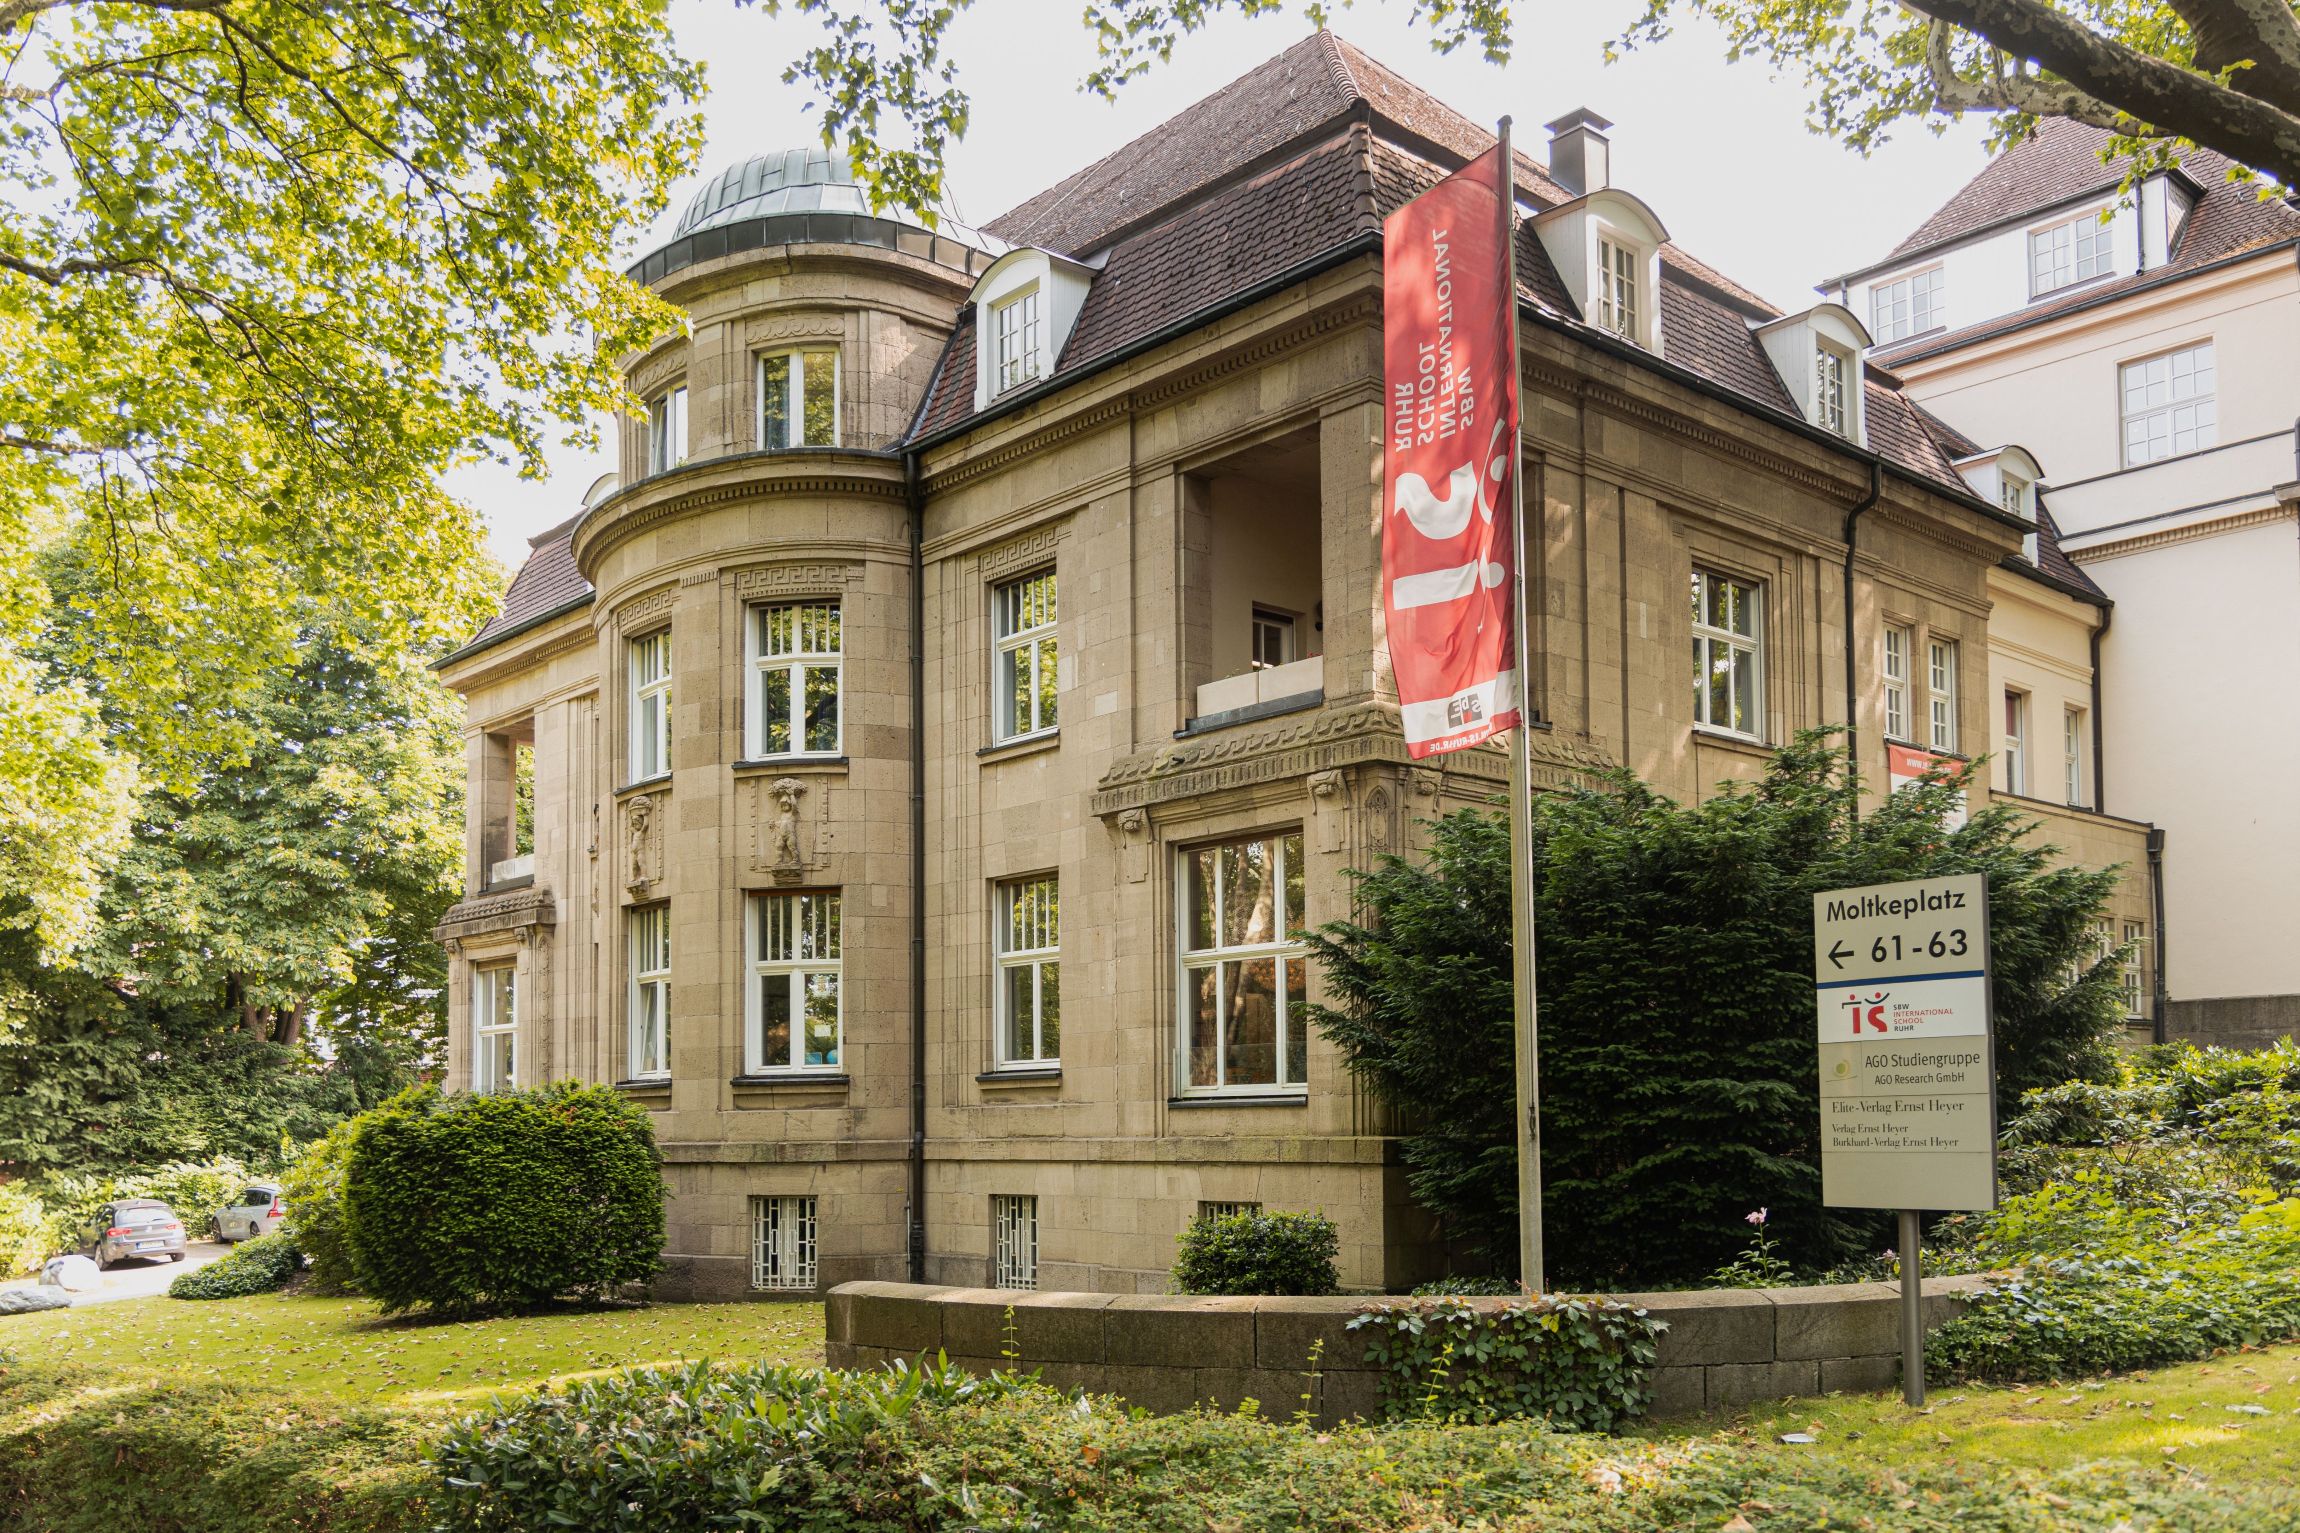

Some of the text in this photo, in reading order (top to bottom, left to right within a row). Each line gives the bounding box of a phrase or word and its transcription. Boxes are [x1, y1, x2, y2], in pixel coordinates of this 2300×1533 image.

[1826, 889, 1966, 922] Moltkeplatz
[1893, 1003, 1910, 1011] SBW
[1893, 1008, 1953, 1018] INTERNATIONAL
[1893, 1017, 1924, 1025] SCHOOL
[1894, 1024, 1914, 1032] RUHR
[1865, 1053, 1981, 1070] AGO Studiengruppe
[1875, 1072, 1965, 1085] AGO Research GmbH
[1832, 1099, 1965, 1115] Elite-Verlag Ernst Heyer
[1832, 1123, 1909, 1135] Verlag Ernst Heyer
[1833, 1136, 1959, 1150] Burkhard-Verlag Ernst Heyer
